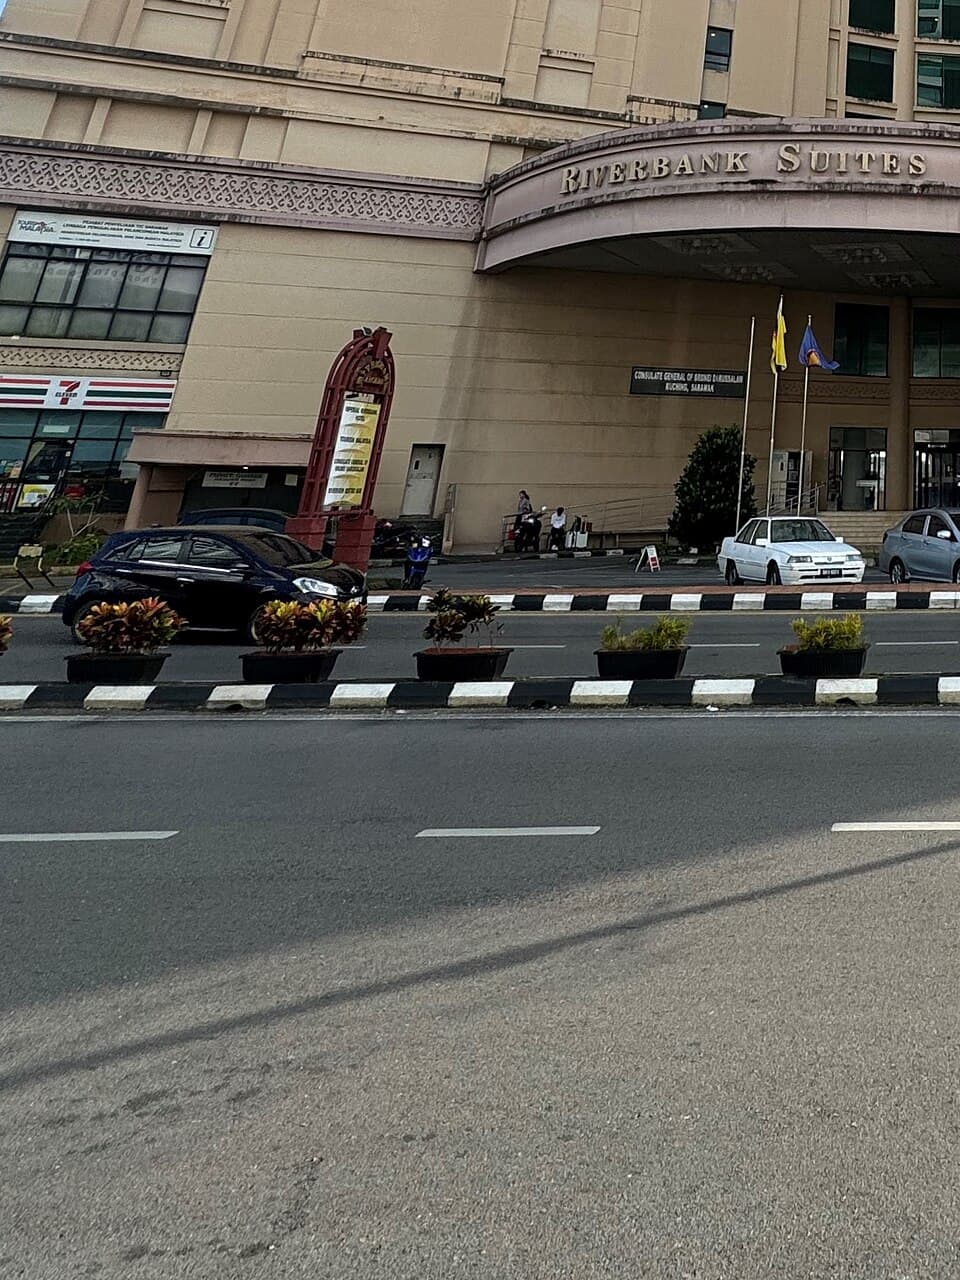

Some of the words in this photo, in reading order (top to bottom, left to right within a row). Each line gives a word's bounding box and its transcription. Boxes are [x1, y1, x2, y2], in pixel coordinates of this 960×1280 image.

[559, 151, 748, 195] RIVERBANK
[776, 143, 927, 175] SUITES
[634, 371, 663, 380] CONSULATE
[664, 371, 685, 381] GENERAL
[59, 381, 80, 405] 7
